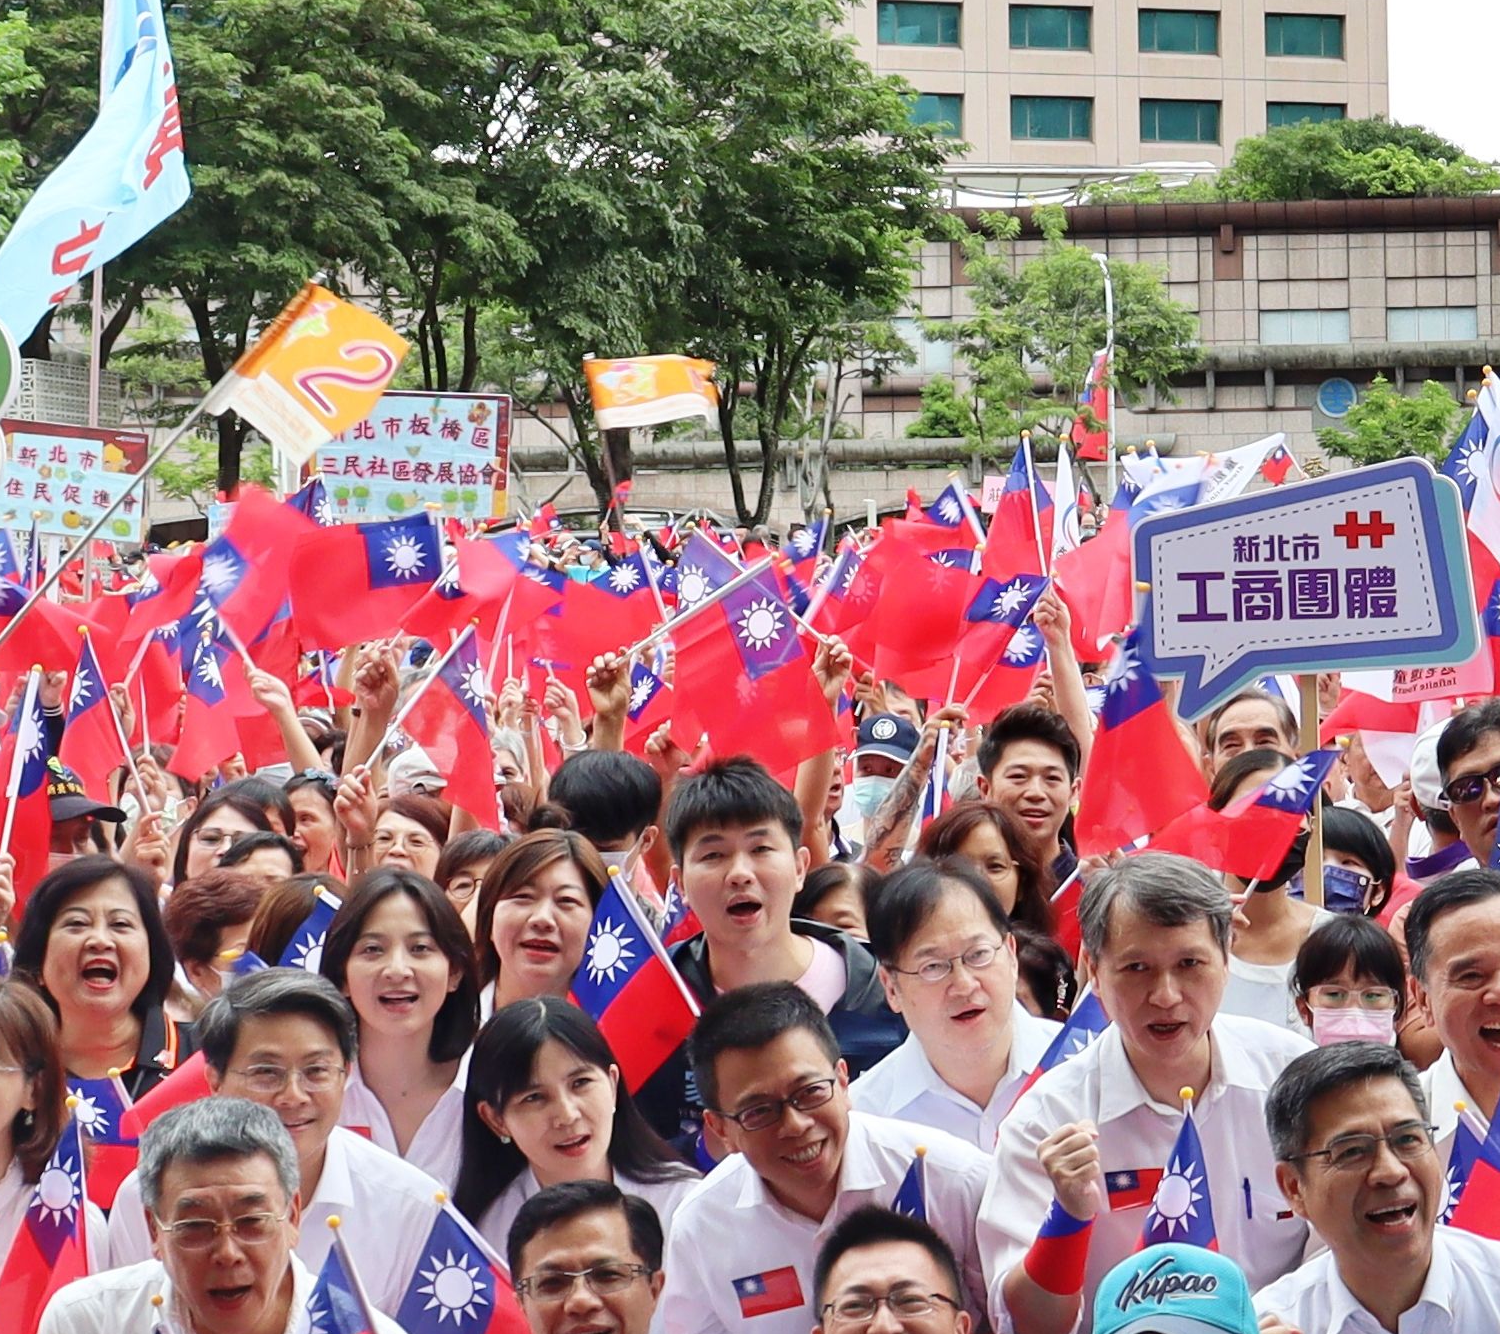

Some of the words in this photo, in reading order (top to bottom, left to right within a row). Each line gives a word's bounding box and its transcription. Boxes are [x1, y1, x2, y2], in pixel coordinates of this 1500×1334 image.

[17, 443, 97, 471] 新北市
[321, 454, 499, 486] 三民社區發展協會
[1233, 533, 1320, 563] 新北市
[1176, 566, 1399, 623] 工商團體
[1117, 1255, 1219, 1315] Kupao
